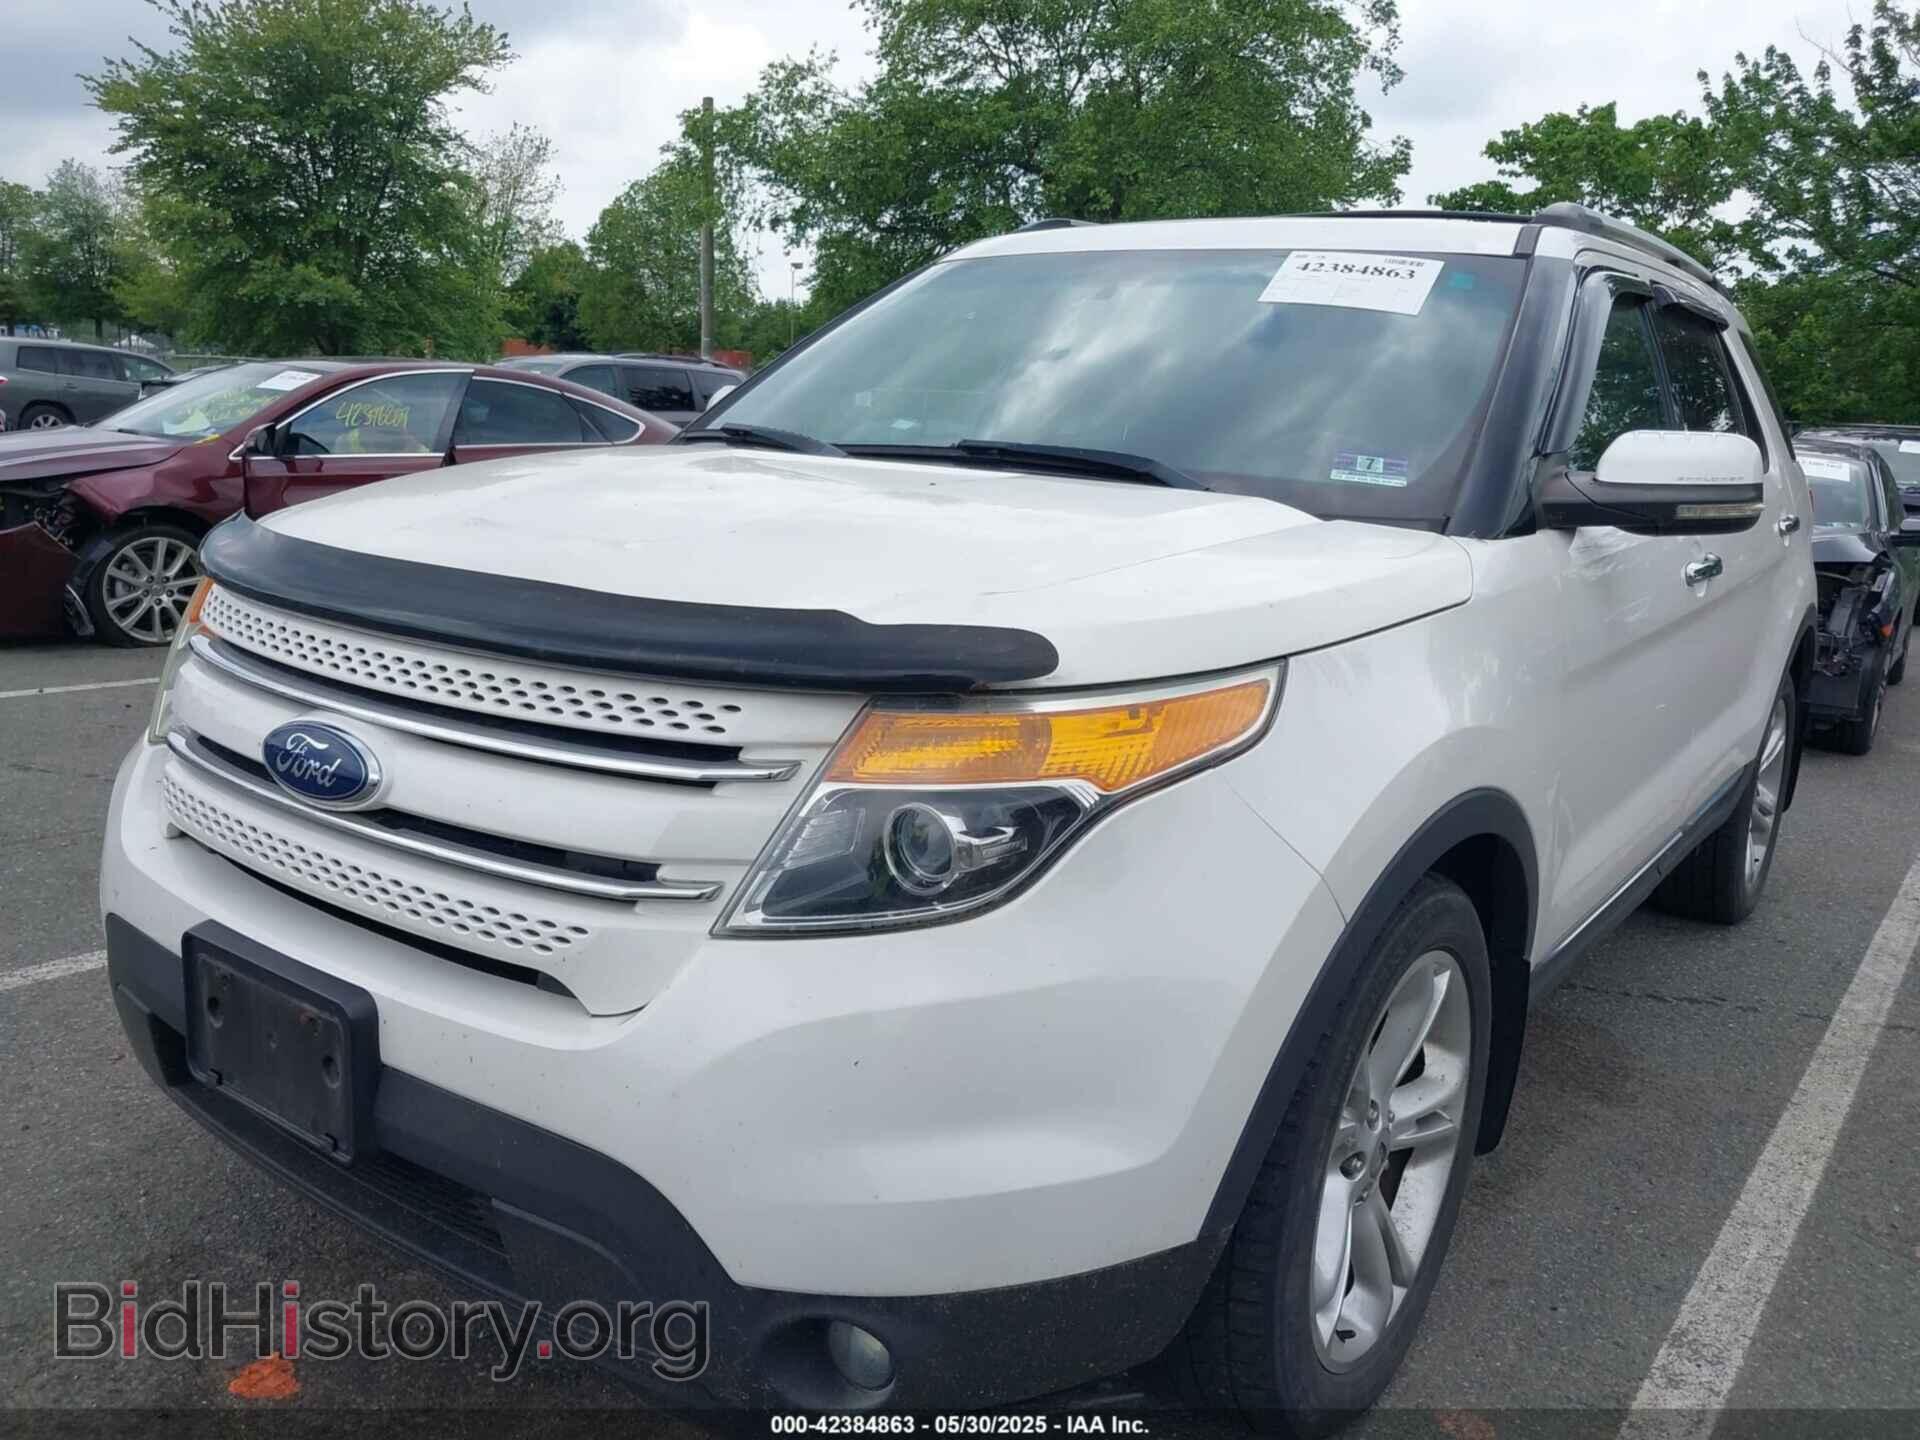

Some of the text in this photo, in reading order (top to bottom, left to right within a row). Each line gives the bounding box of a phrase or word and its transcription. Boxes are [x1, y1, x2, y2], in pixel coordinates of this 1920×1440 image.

[1296, 262, 1416, 280] 42384863
[1365, 458, 1376, 470] 7
[276, 732, 342, 788] Ford
